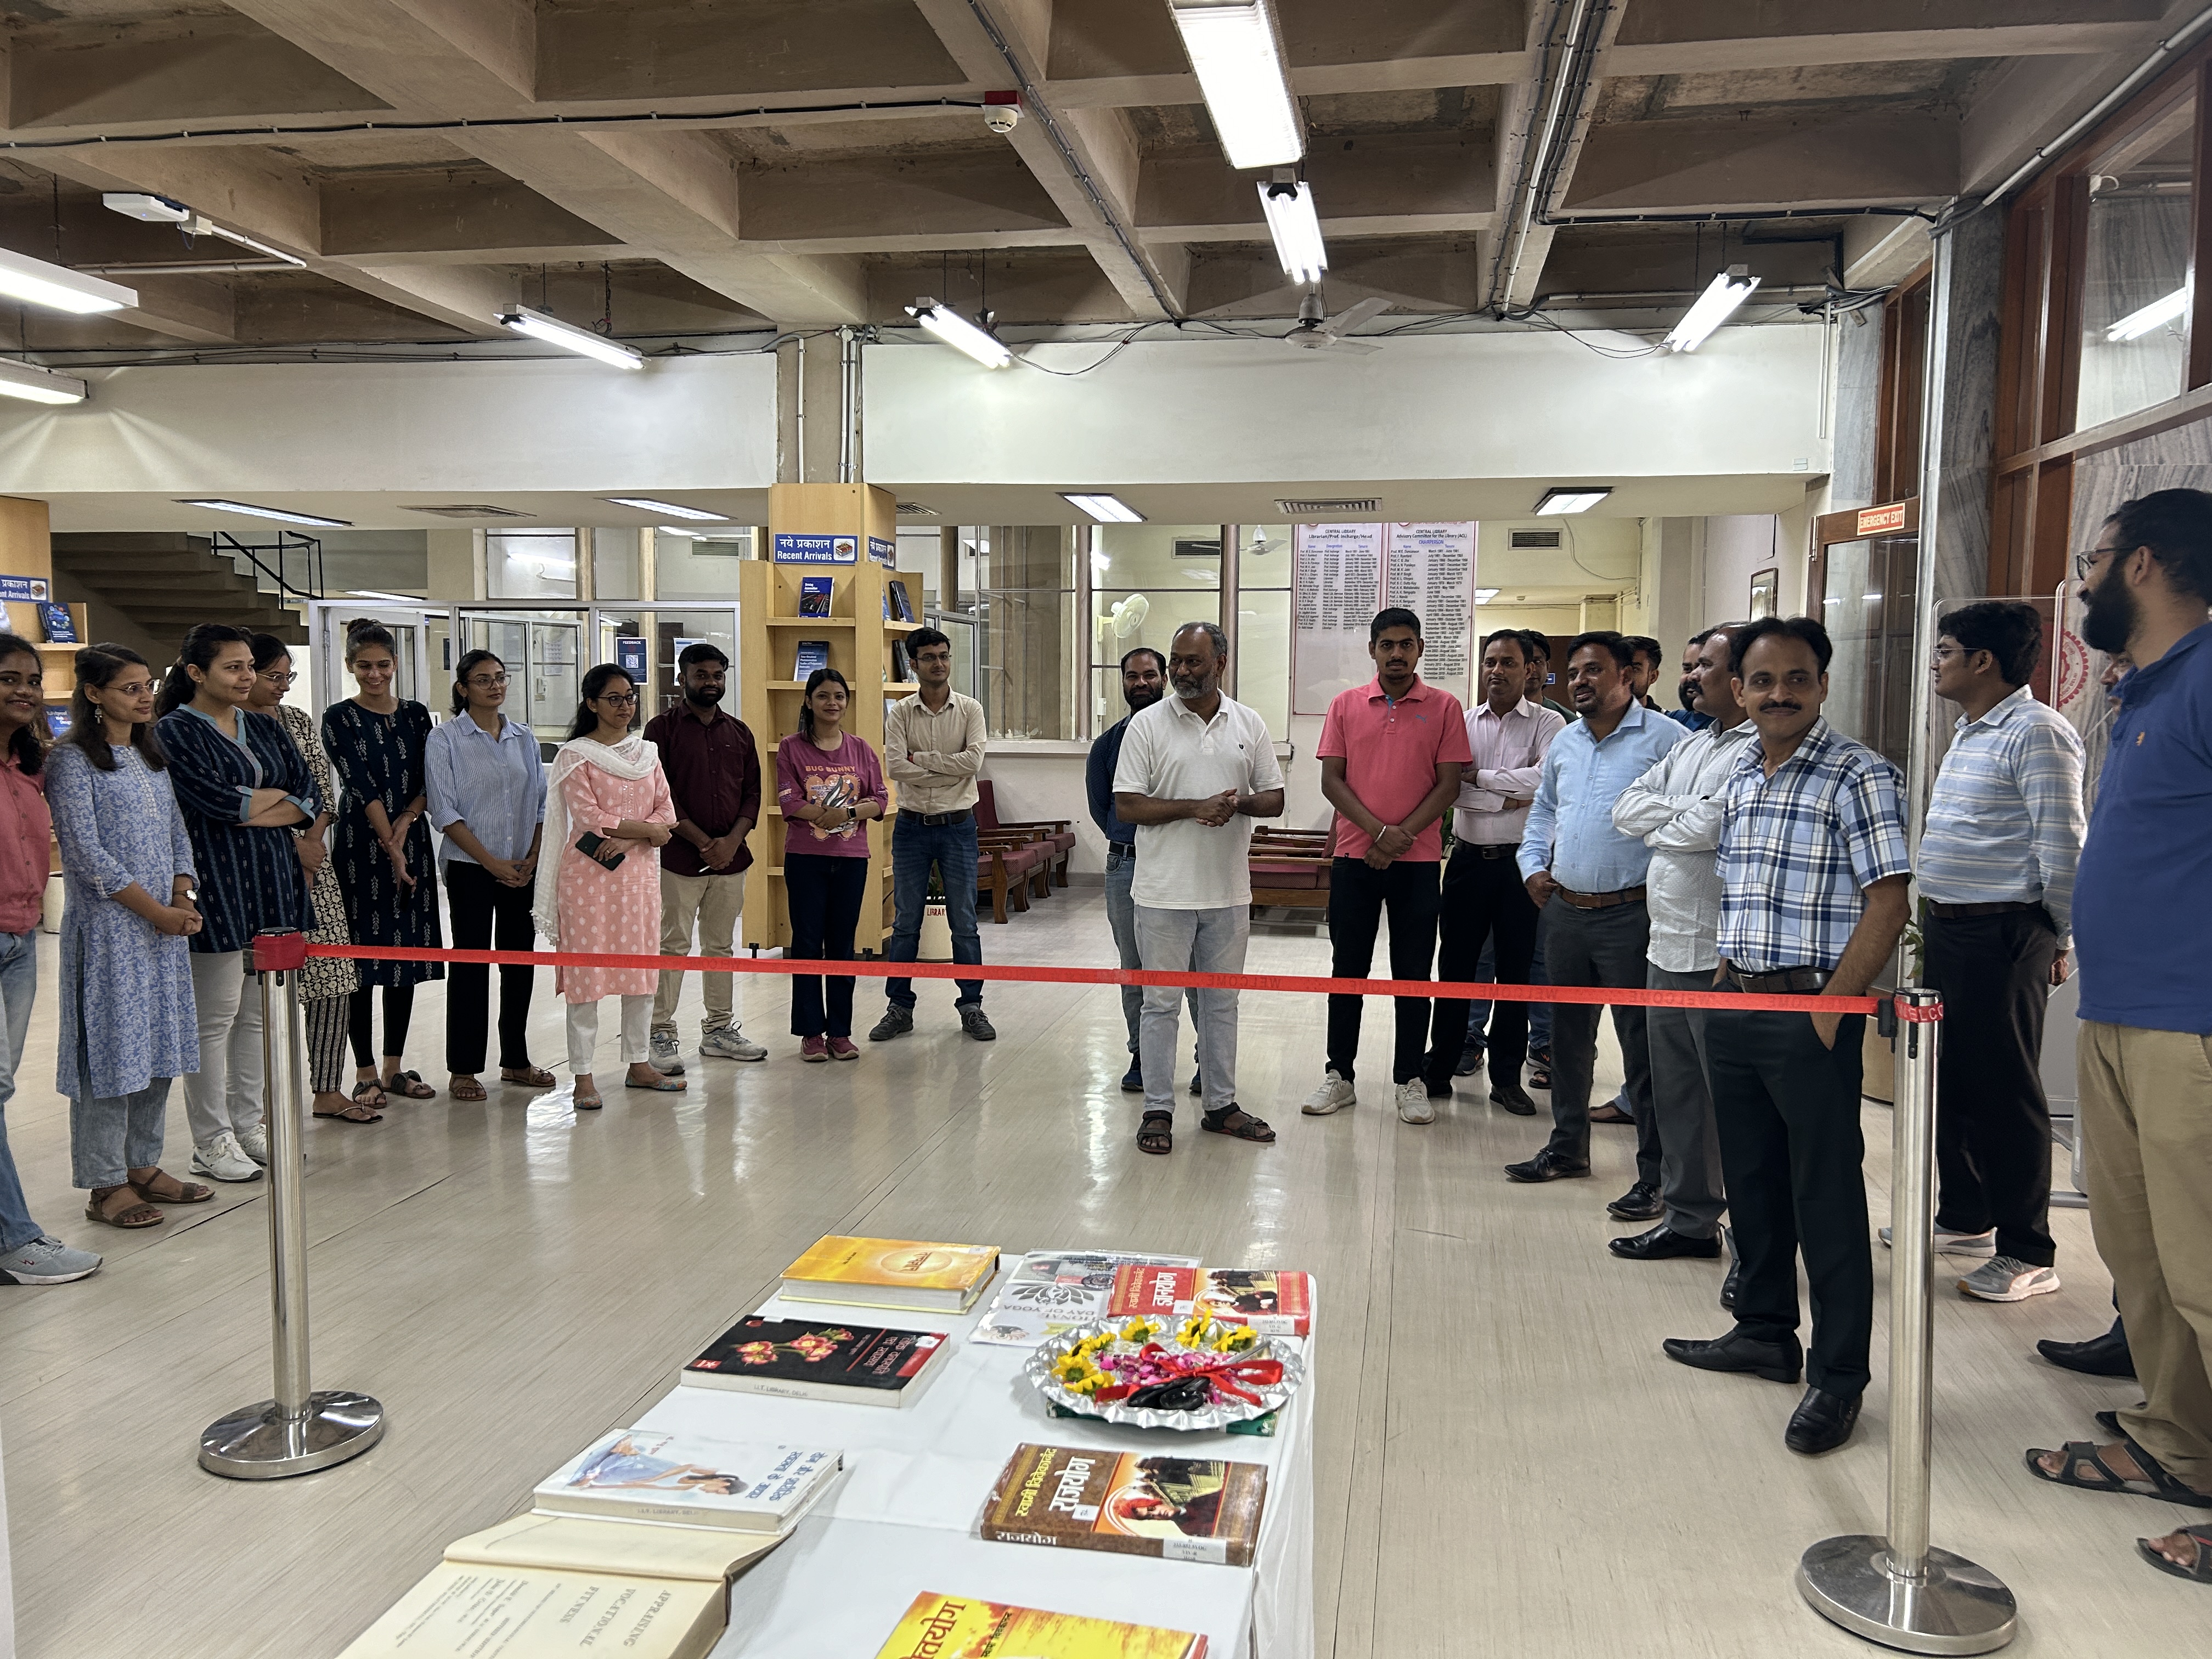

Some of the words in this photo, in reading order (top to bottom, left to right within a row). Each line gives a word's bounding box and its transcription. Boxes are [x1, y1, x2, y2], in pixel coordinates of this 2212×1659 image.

[1860, 512, 1891, 528] EMERGENCY
[1891, 510, 1903, 524] EXIT
[779, 536, 794, 548] नये
[796, 539, 831, 549] प्रकाशन
[777, 551, 803, 560] Recent
[804, 551, 832, 560] Arrivals
[1, 579, 28, 589] प्रकाशन
[8, 590, 30, 600] Arrivals
[927, 908, 946, 916] LIBRAR
[1025, 1447, 1058, 1488] विवेकानंद
[1048, 1456, 1096, 1511] राजयोग
[1015, 1488, 1038, 1517] स्वामी
[559, 1585, 600, 1624] FITNESS
[579, 1588, 636, 1647] VOCATIONAL
[624, 1589, 672, 1647] APPRAISING
